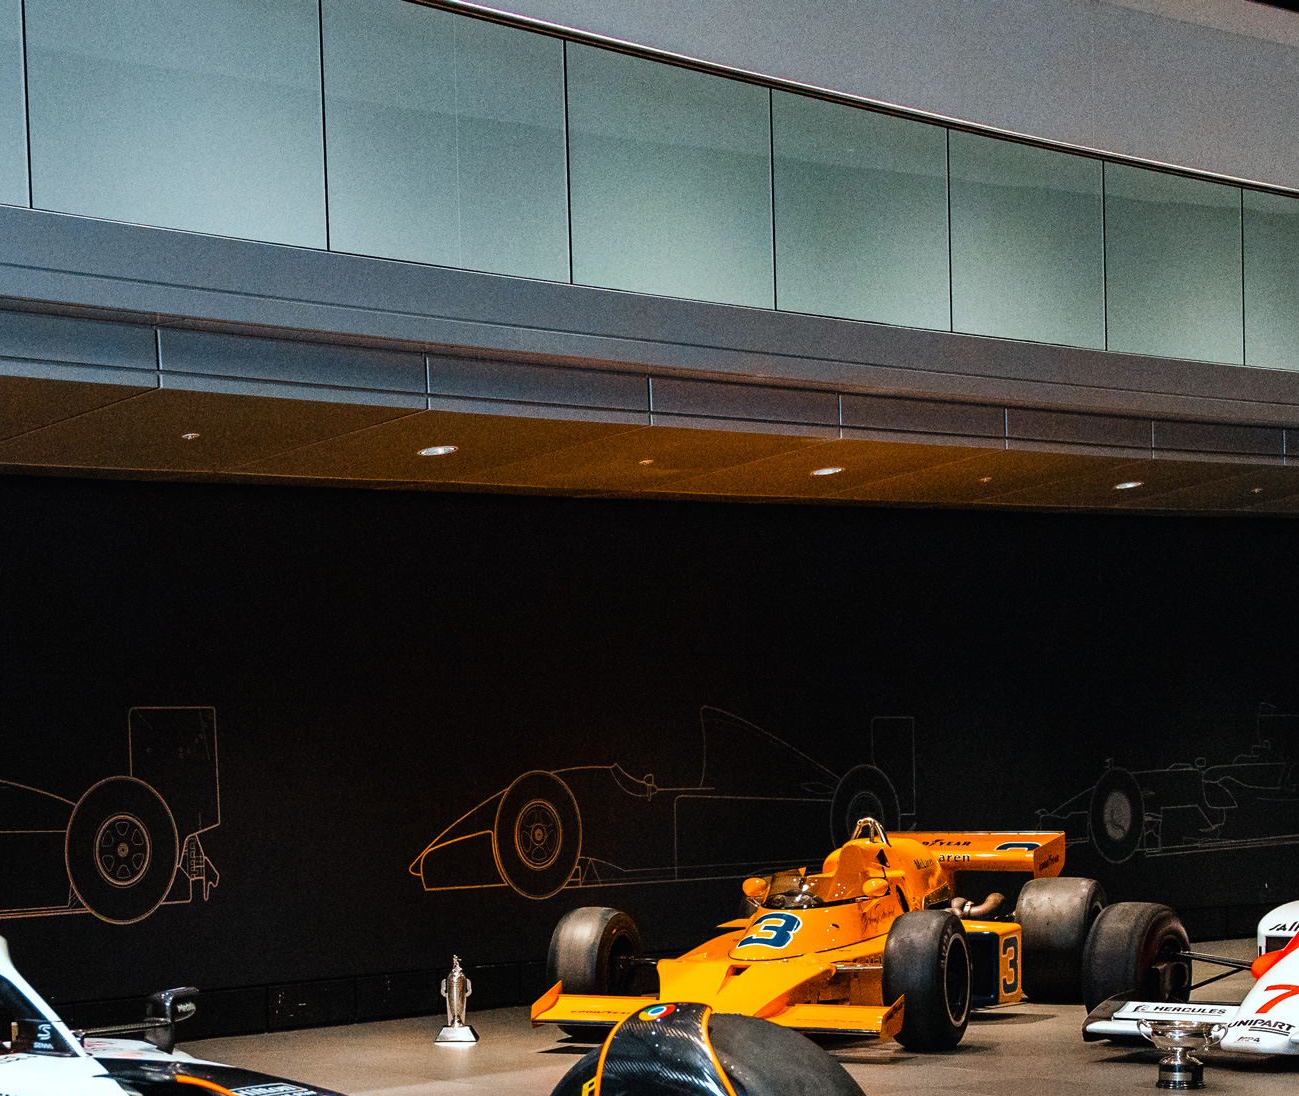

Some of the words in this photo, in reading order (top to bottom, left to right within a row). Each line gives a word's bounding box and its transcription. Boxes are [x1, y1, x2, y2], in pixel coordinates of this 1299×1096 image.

[939, 854, 971, 862] aren
[735, 911, 803, 949] 3
[1001, 934, 1020, 996] 3
[1153, 1006, 1227, 1015] HERCULES
[1228, 1018, 1296, 1032] UNIPART
